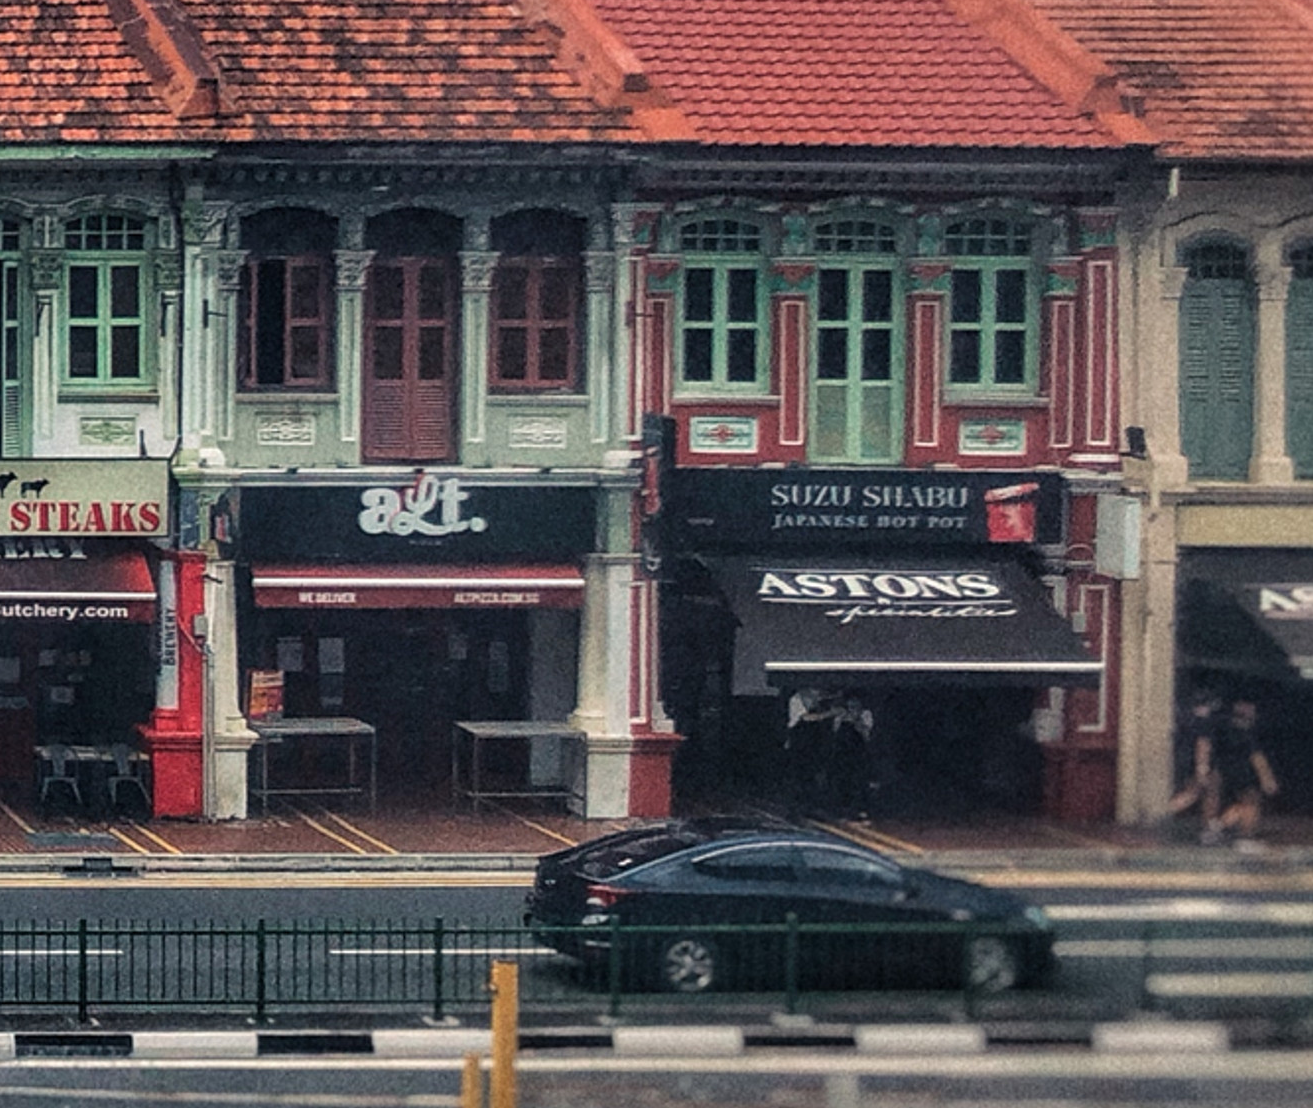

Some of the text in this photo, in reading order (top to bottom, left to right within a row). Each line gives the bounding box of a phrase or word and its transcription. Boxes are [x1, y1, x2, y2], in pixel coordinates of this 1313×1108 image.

[771, 484, 970, 509] SUZU SHABU
[10, 501, 160, 533] STEAKS
[771, 514, 968, 529] JAPANESE HOT POT
[757, 571, 1001, 599] ASTONS
